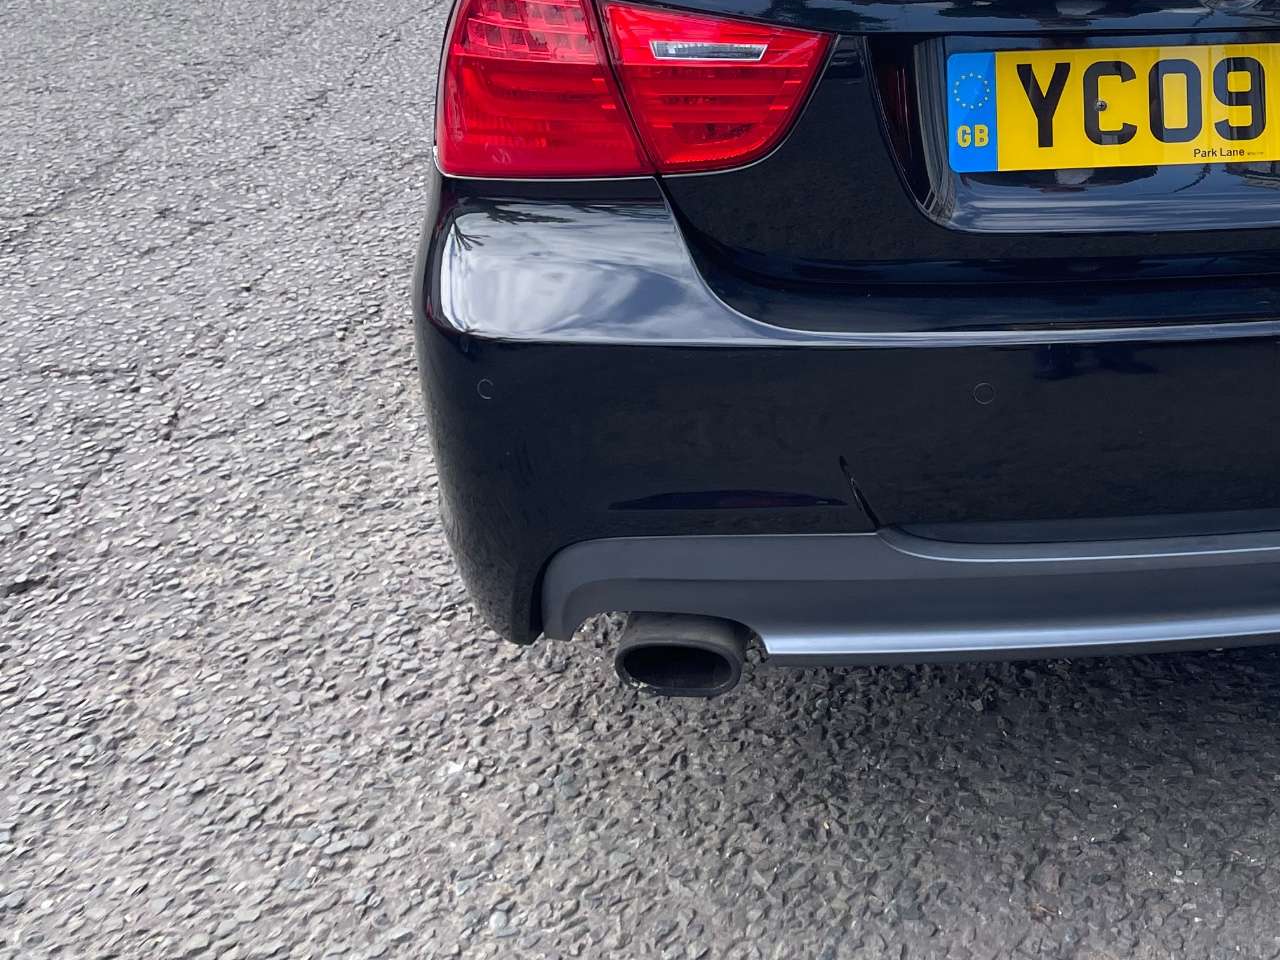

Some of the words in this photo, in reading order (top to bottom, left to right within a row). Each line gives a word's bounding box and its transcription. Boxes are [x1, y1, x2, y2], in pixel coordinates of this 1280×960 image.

[1016, 56, 1268, 149] YC09
[956, 124, 990, 149] GB
[1193, 148, 1217, 158] Park
[1219, 147, 1245, 157] Lane
